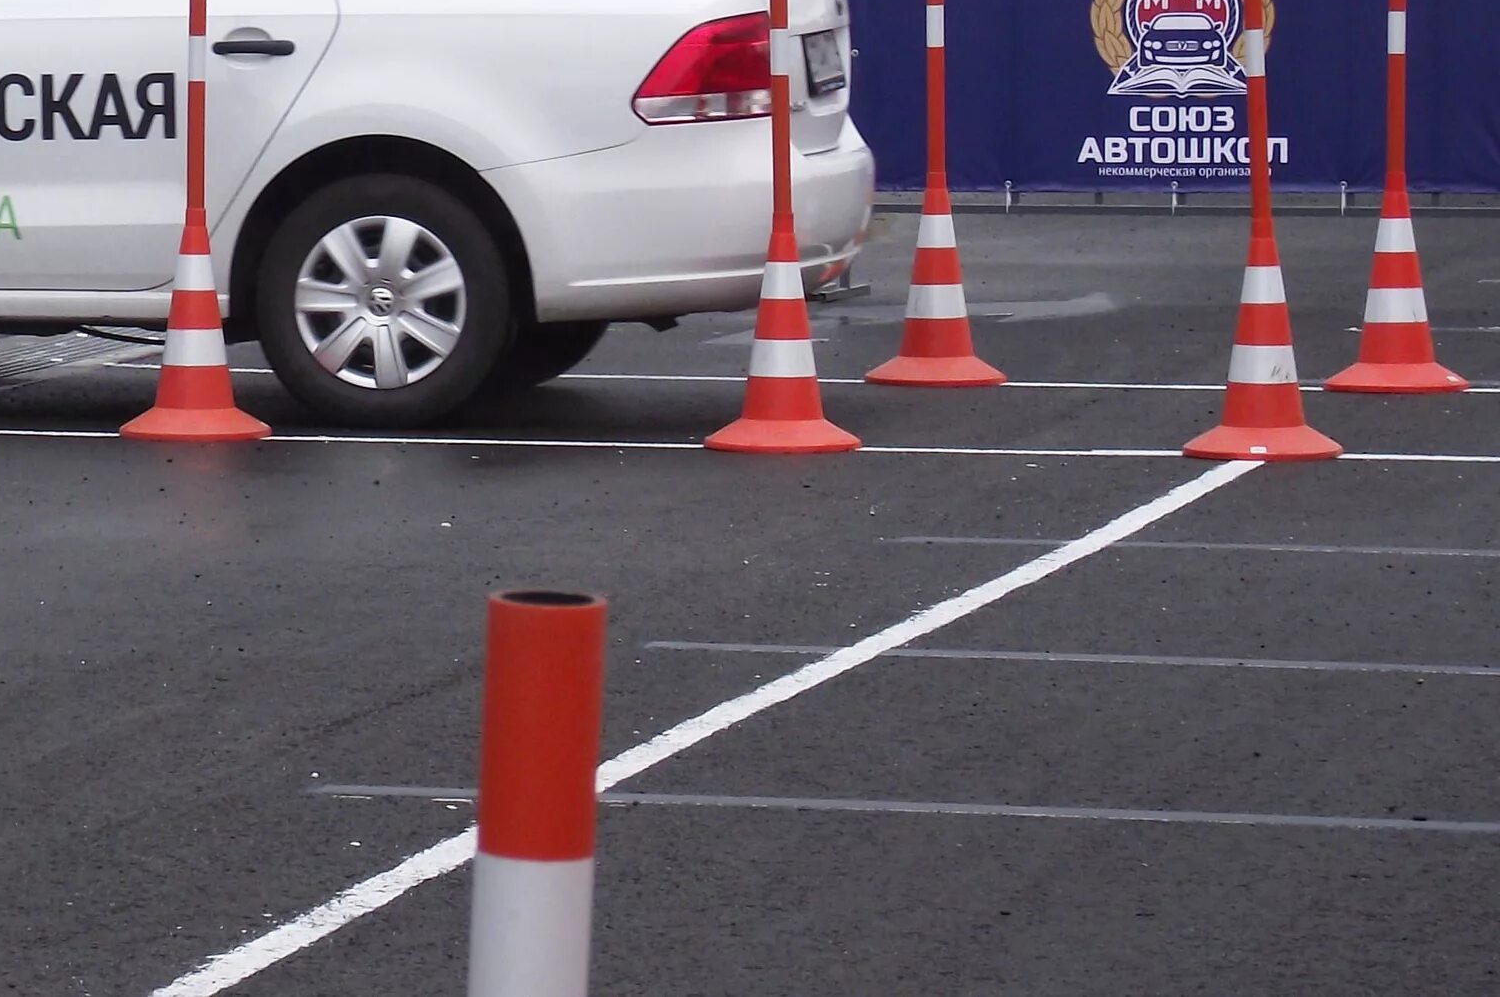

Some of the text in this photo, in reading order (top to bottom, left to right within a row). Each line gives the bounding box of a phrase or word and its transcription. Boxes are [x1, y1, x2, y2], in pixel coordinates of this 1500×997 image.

[1129, 106, 1235, 132] СОЮЗ
[1099, 166, 1272, 179] некоммерческая организа
